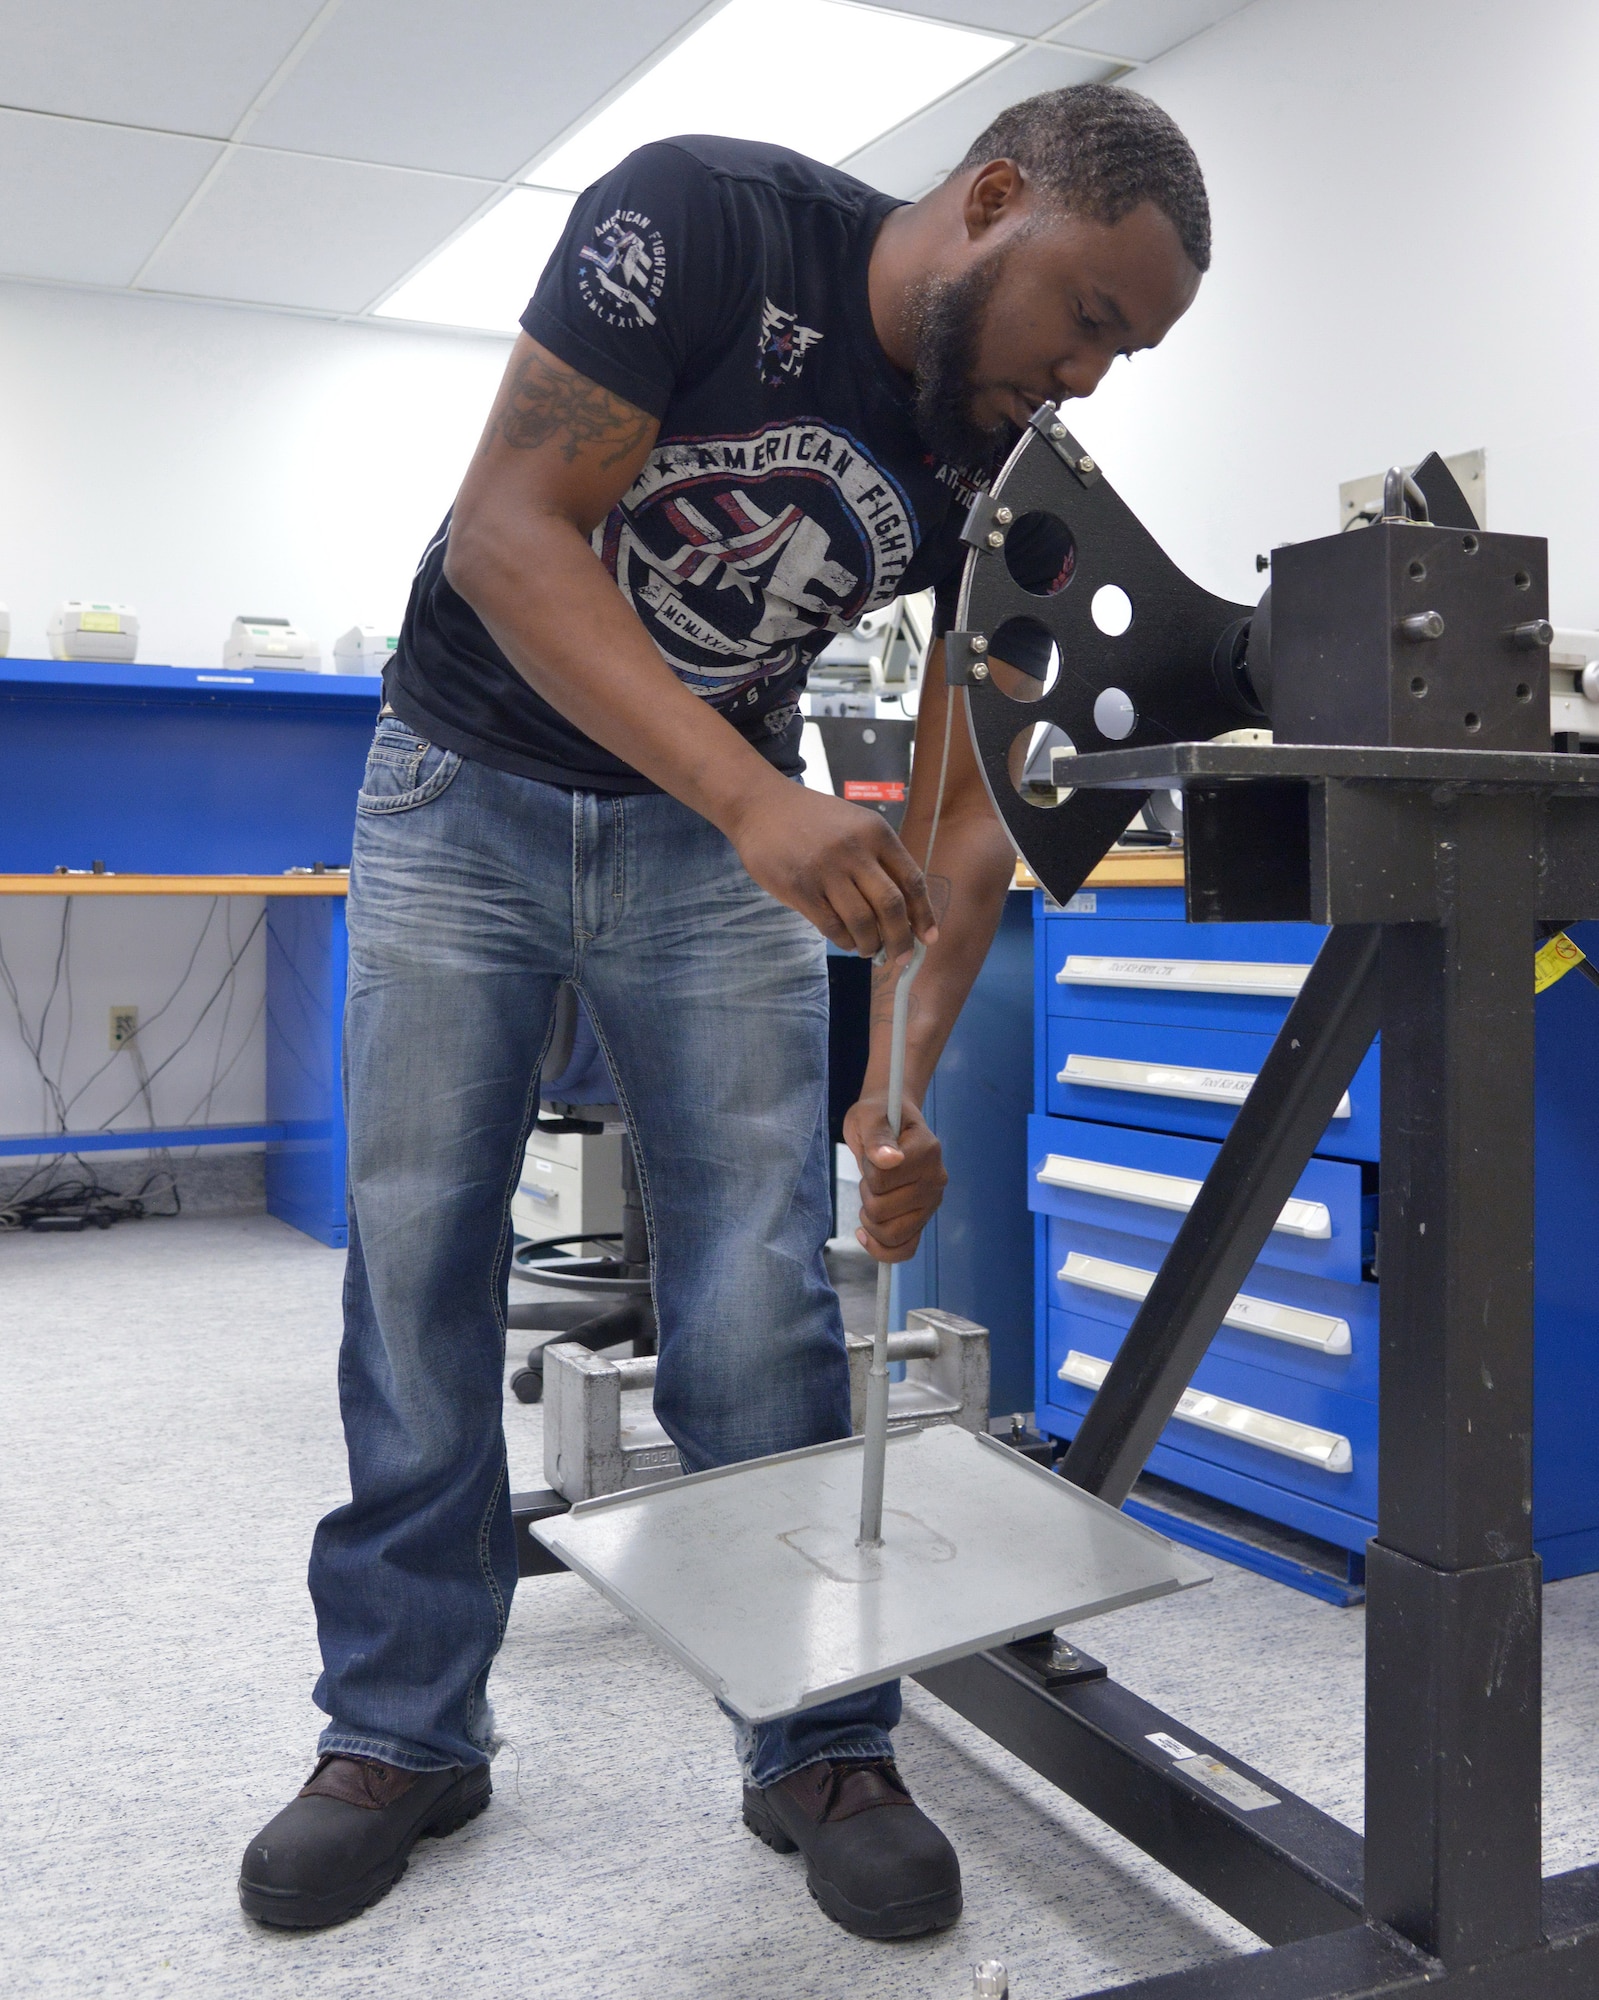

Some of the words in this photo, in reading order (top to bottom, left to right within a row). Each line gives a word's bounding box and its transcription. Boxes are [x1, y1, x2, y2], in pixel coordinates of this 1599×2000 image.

[595, 209, 651, 237] AMERICAN
[648, 231, 666, 297] FIGHTER
[699, 432, 854, 478] AMERICAN
[857, 484, 908, 601] FIGHTER
